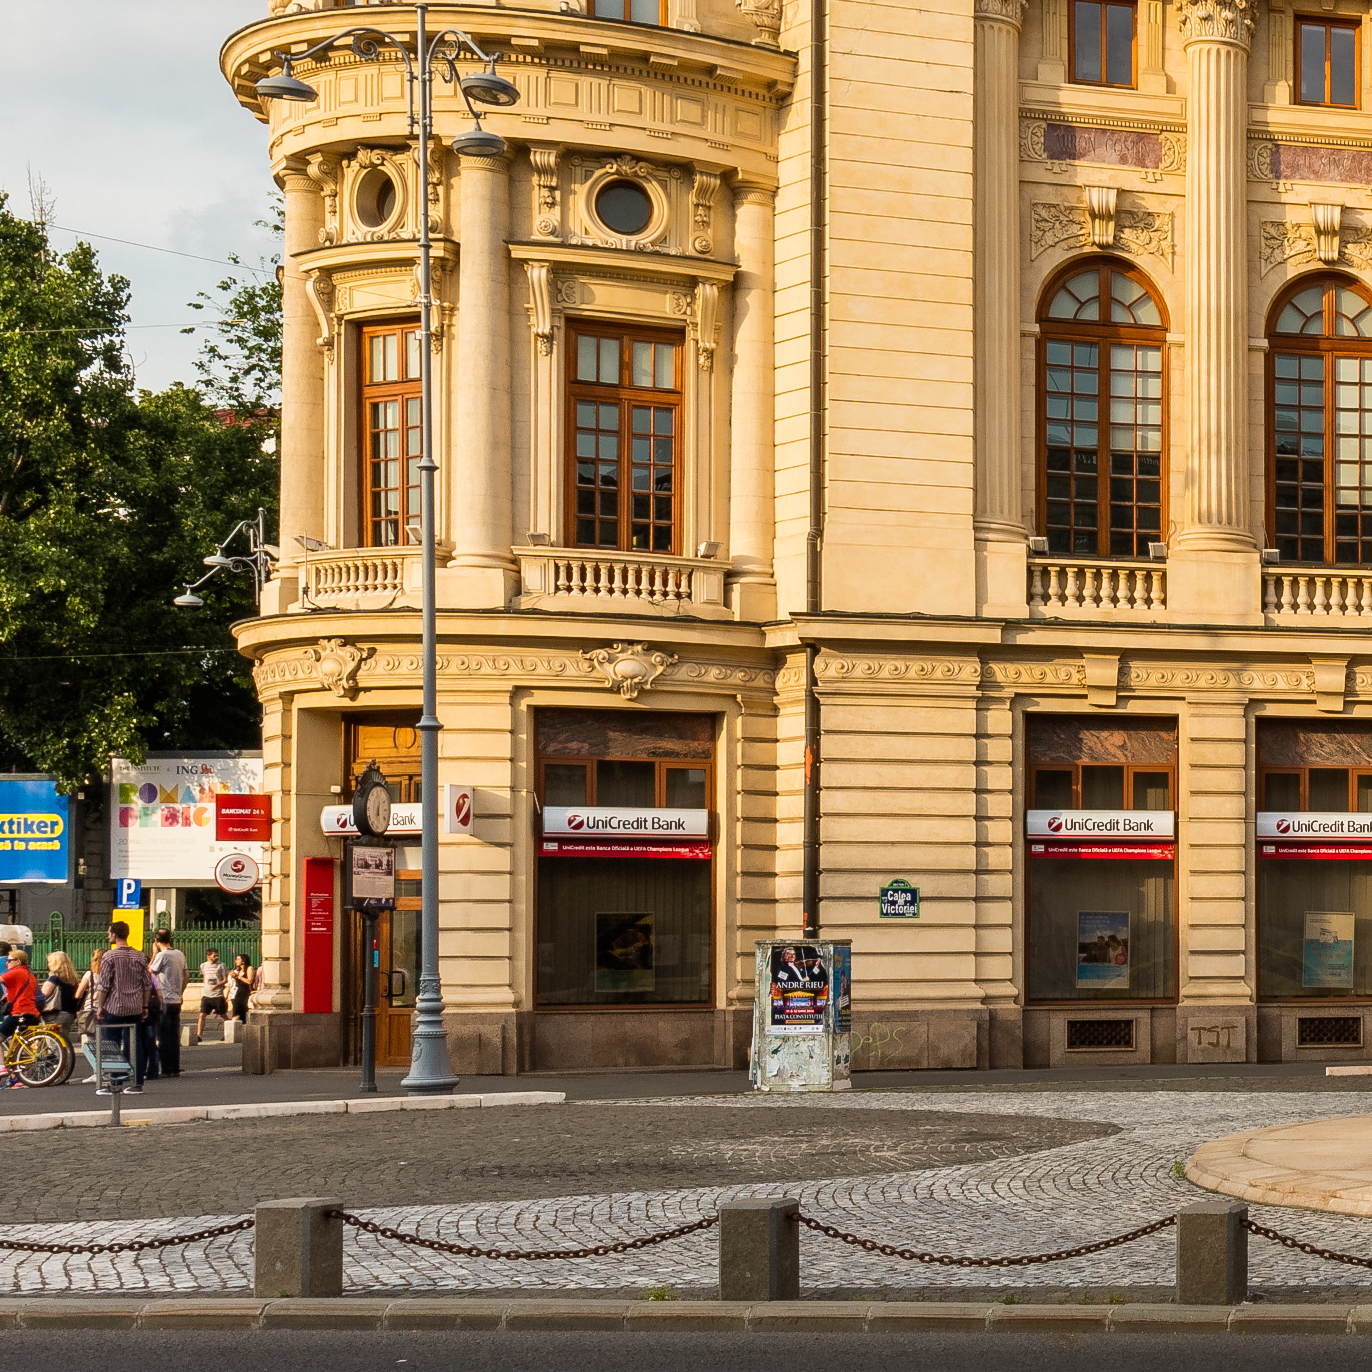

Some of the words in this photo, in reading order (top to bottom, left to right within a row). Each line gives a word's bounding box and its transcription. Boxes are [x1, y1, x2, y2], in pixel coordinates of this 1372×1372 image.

[176, 765, 198, 775] ING
[392, 812, 417, 826] Bank
[586, 815, 648, 831] UniCredit
[652, 816, 686, 831] Bank
[1065, 818, 1120, 832] UniCredit
[1123, 818, 1154, 832] Bank
[1292, 820, 1344, 833] UniCredit
[122, 879, 136, 905] P
[887, 890, 911, 901] Calea
[881, 903, 917, 914] Victoriei
